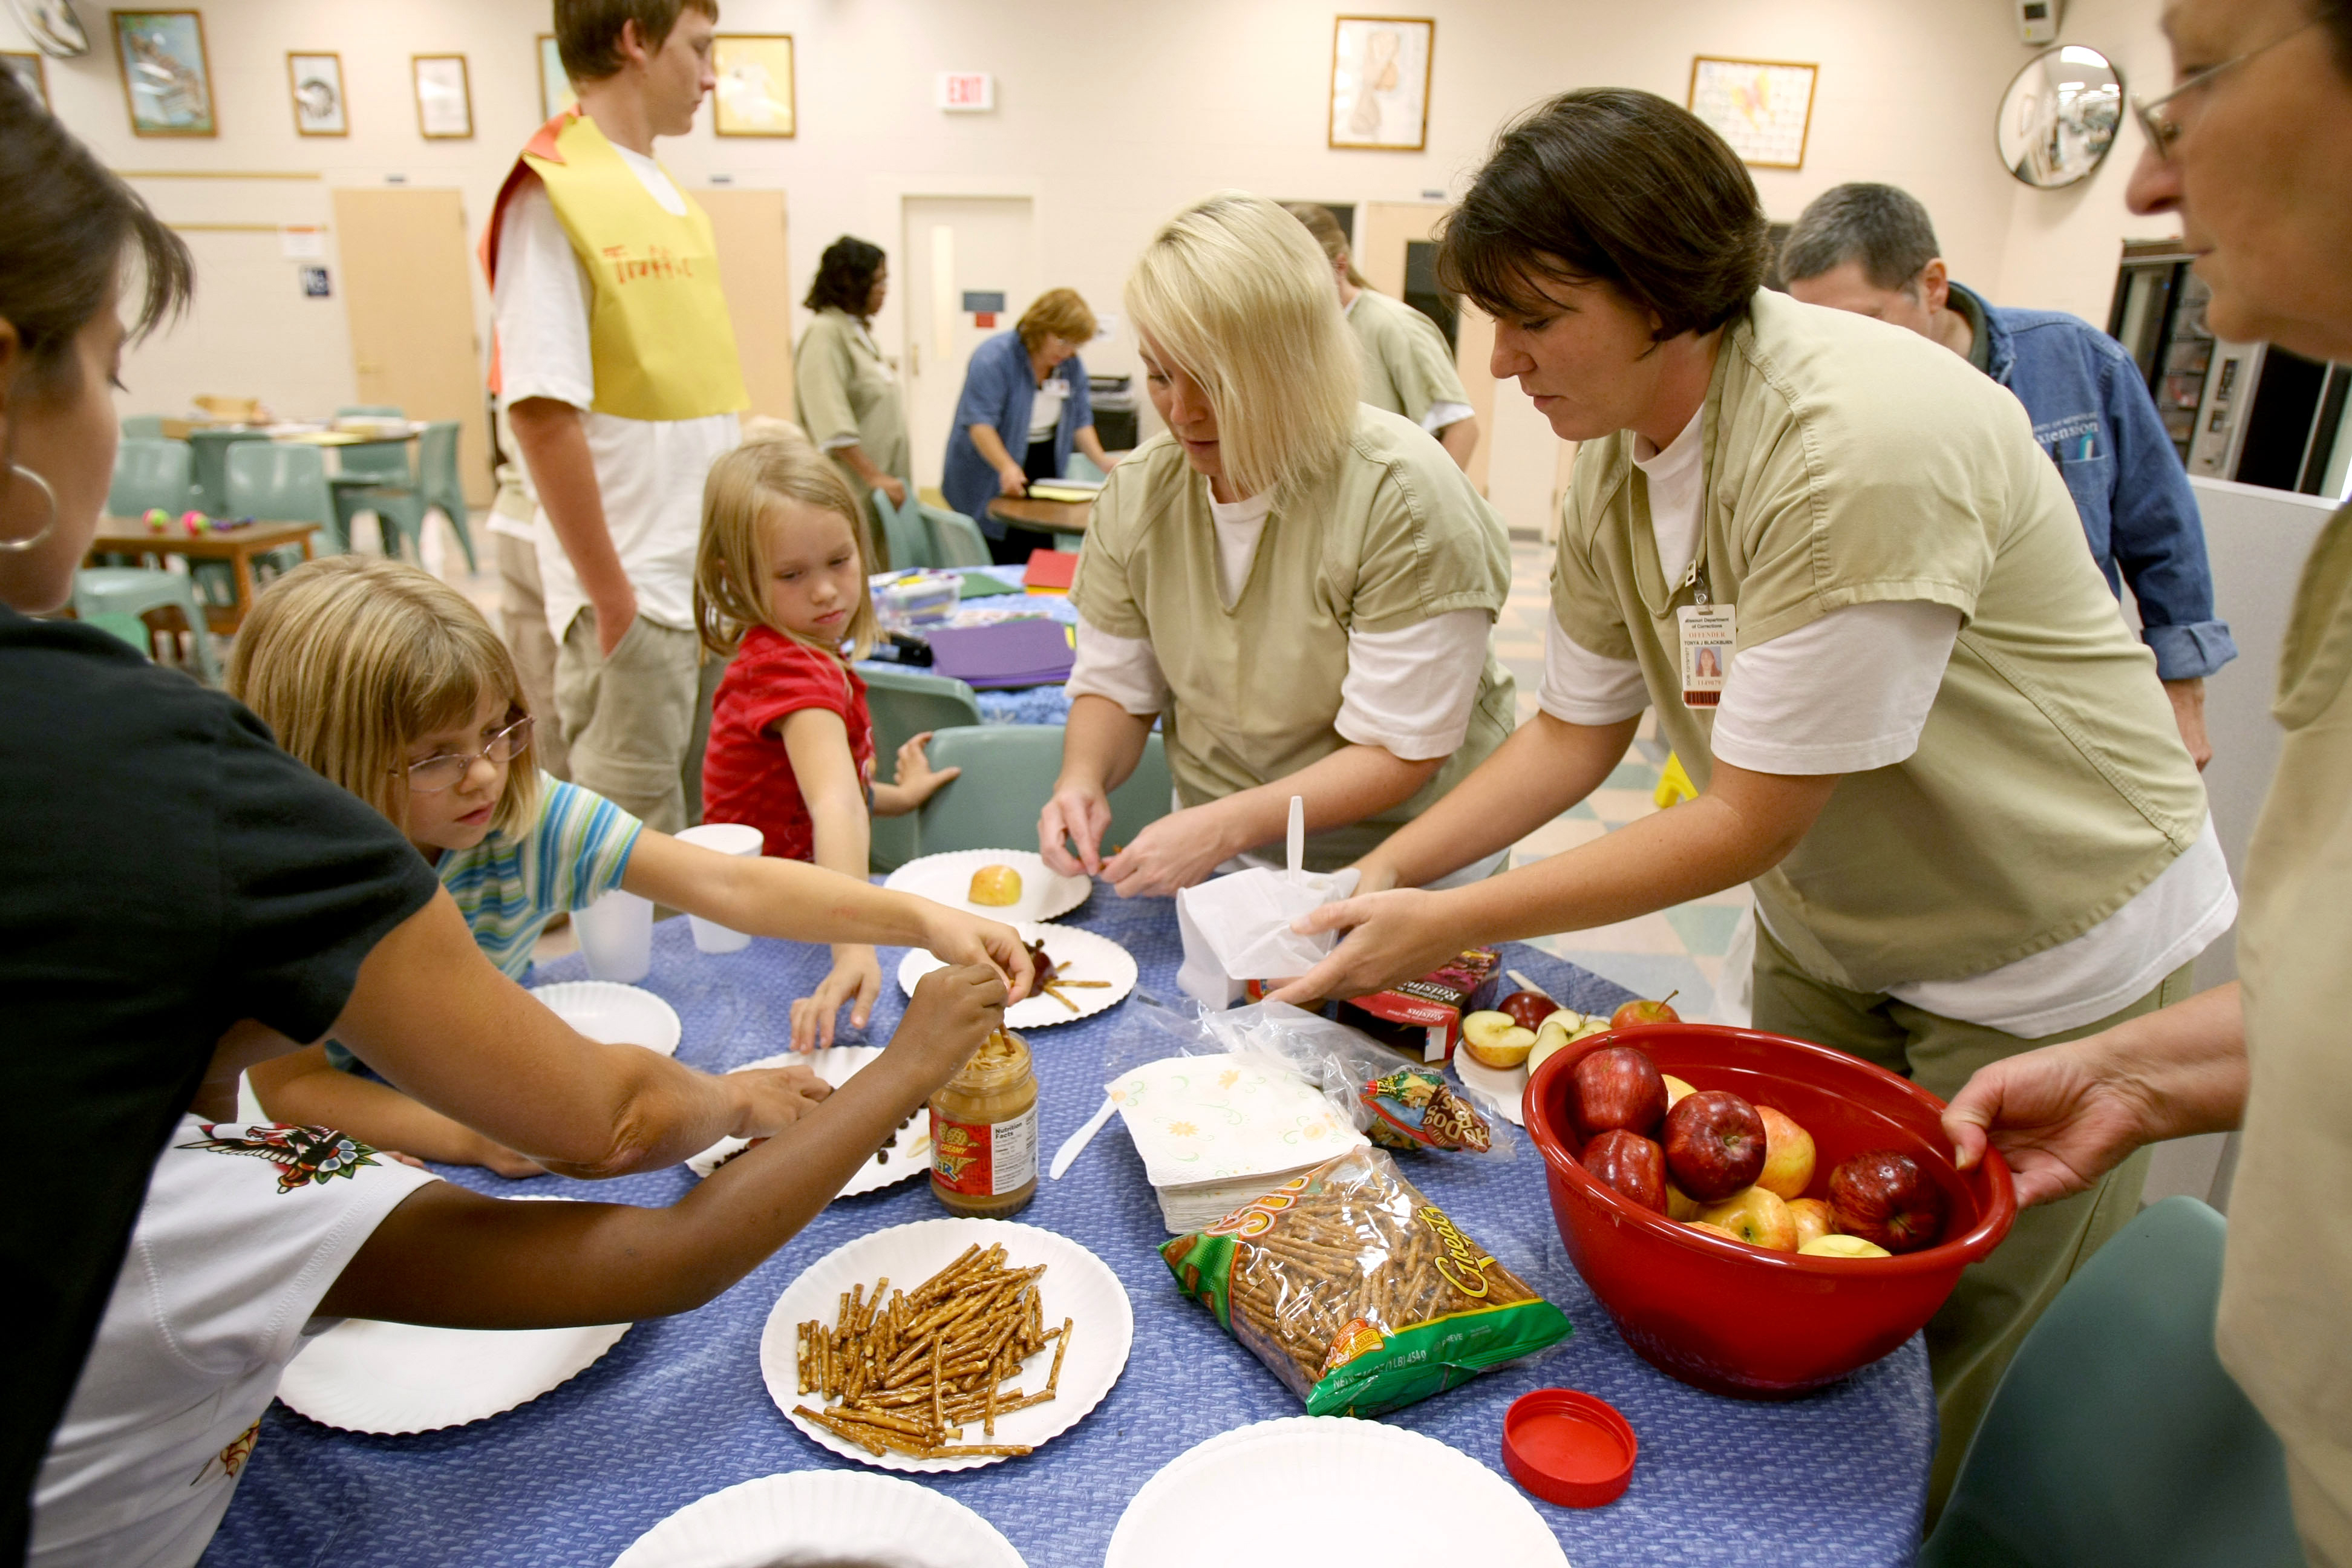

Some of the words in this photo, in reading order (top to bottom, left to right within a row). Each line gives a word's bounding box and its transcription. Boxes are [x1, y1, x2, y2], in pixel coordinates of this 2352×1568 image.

[947, 76, 982, 103] EXIT
[2037, 422, 2099, 444] xtension
[1403, 981, 1462, 1001] Raisin
[1406, 1008, 1444, 1022] Raisins
[995, 1122, 1022, 1134] Nutrition
[1421, 1105, 1462, 1140] Dog
[941, 1143, 968, 1154] CREAMY
[1417, 1206, 1489, 1298] Great
[1393, 1354, 1406, 1368] LB)
